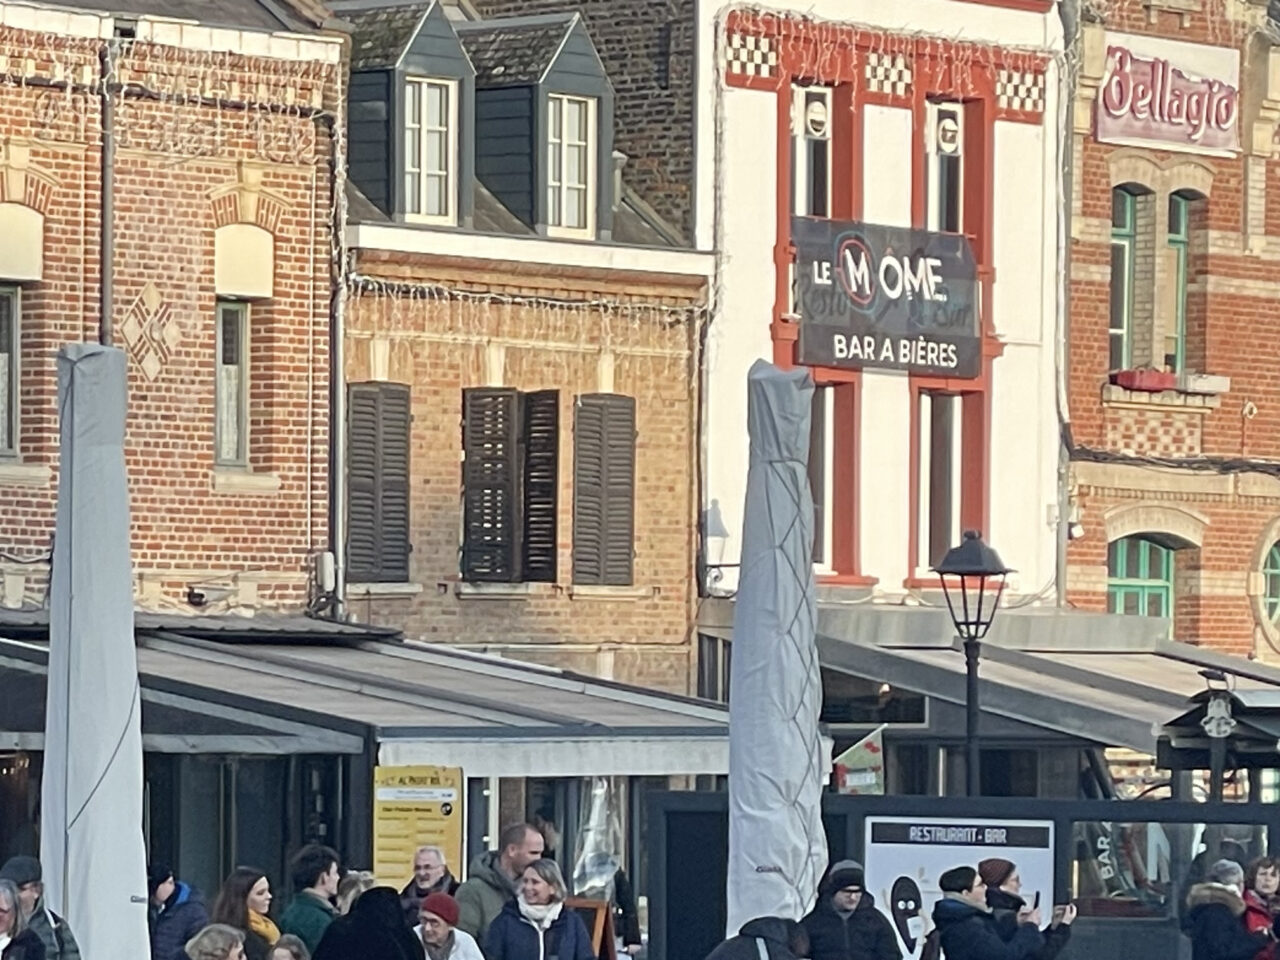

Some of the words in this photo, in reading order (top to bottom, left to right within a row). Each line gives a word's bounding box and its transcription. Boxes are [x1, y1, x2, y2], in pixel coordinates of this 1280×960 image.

[1104, 46, 1237, 143] Bellagio
[813, 261, 832, 285] LE
[834, 334, 875, 360] BAR
[880, 338, 894, 362] A
[899, 335, 958, 368] BIÈRES
[910, 826, 977, 842] RESTAURANT
[985, 828, 1007, 843] BAR
[1097, 836, 1114, 879] BAR
